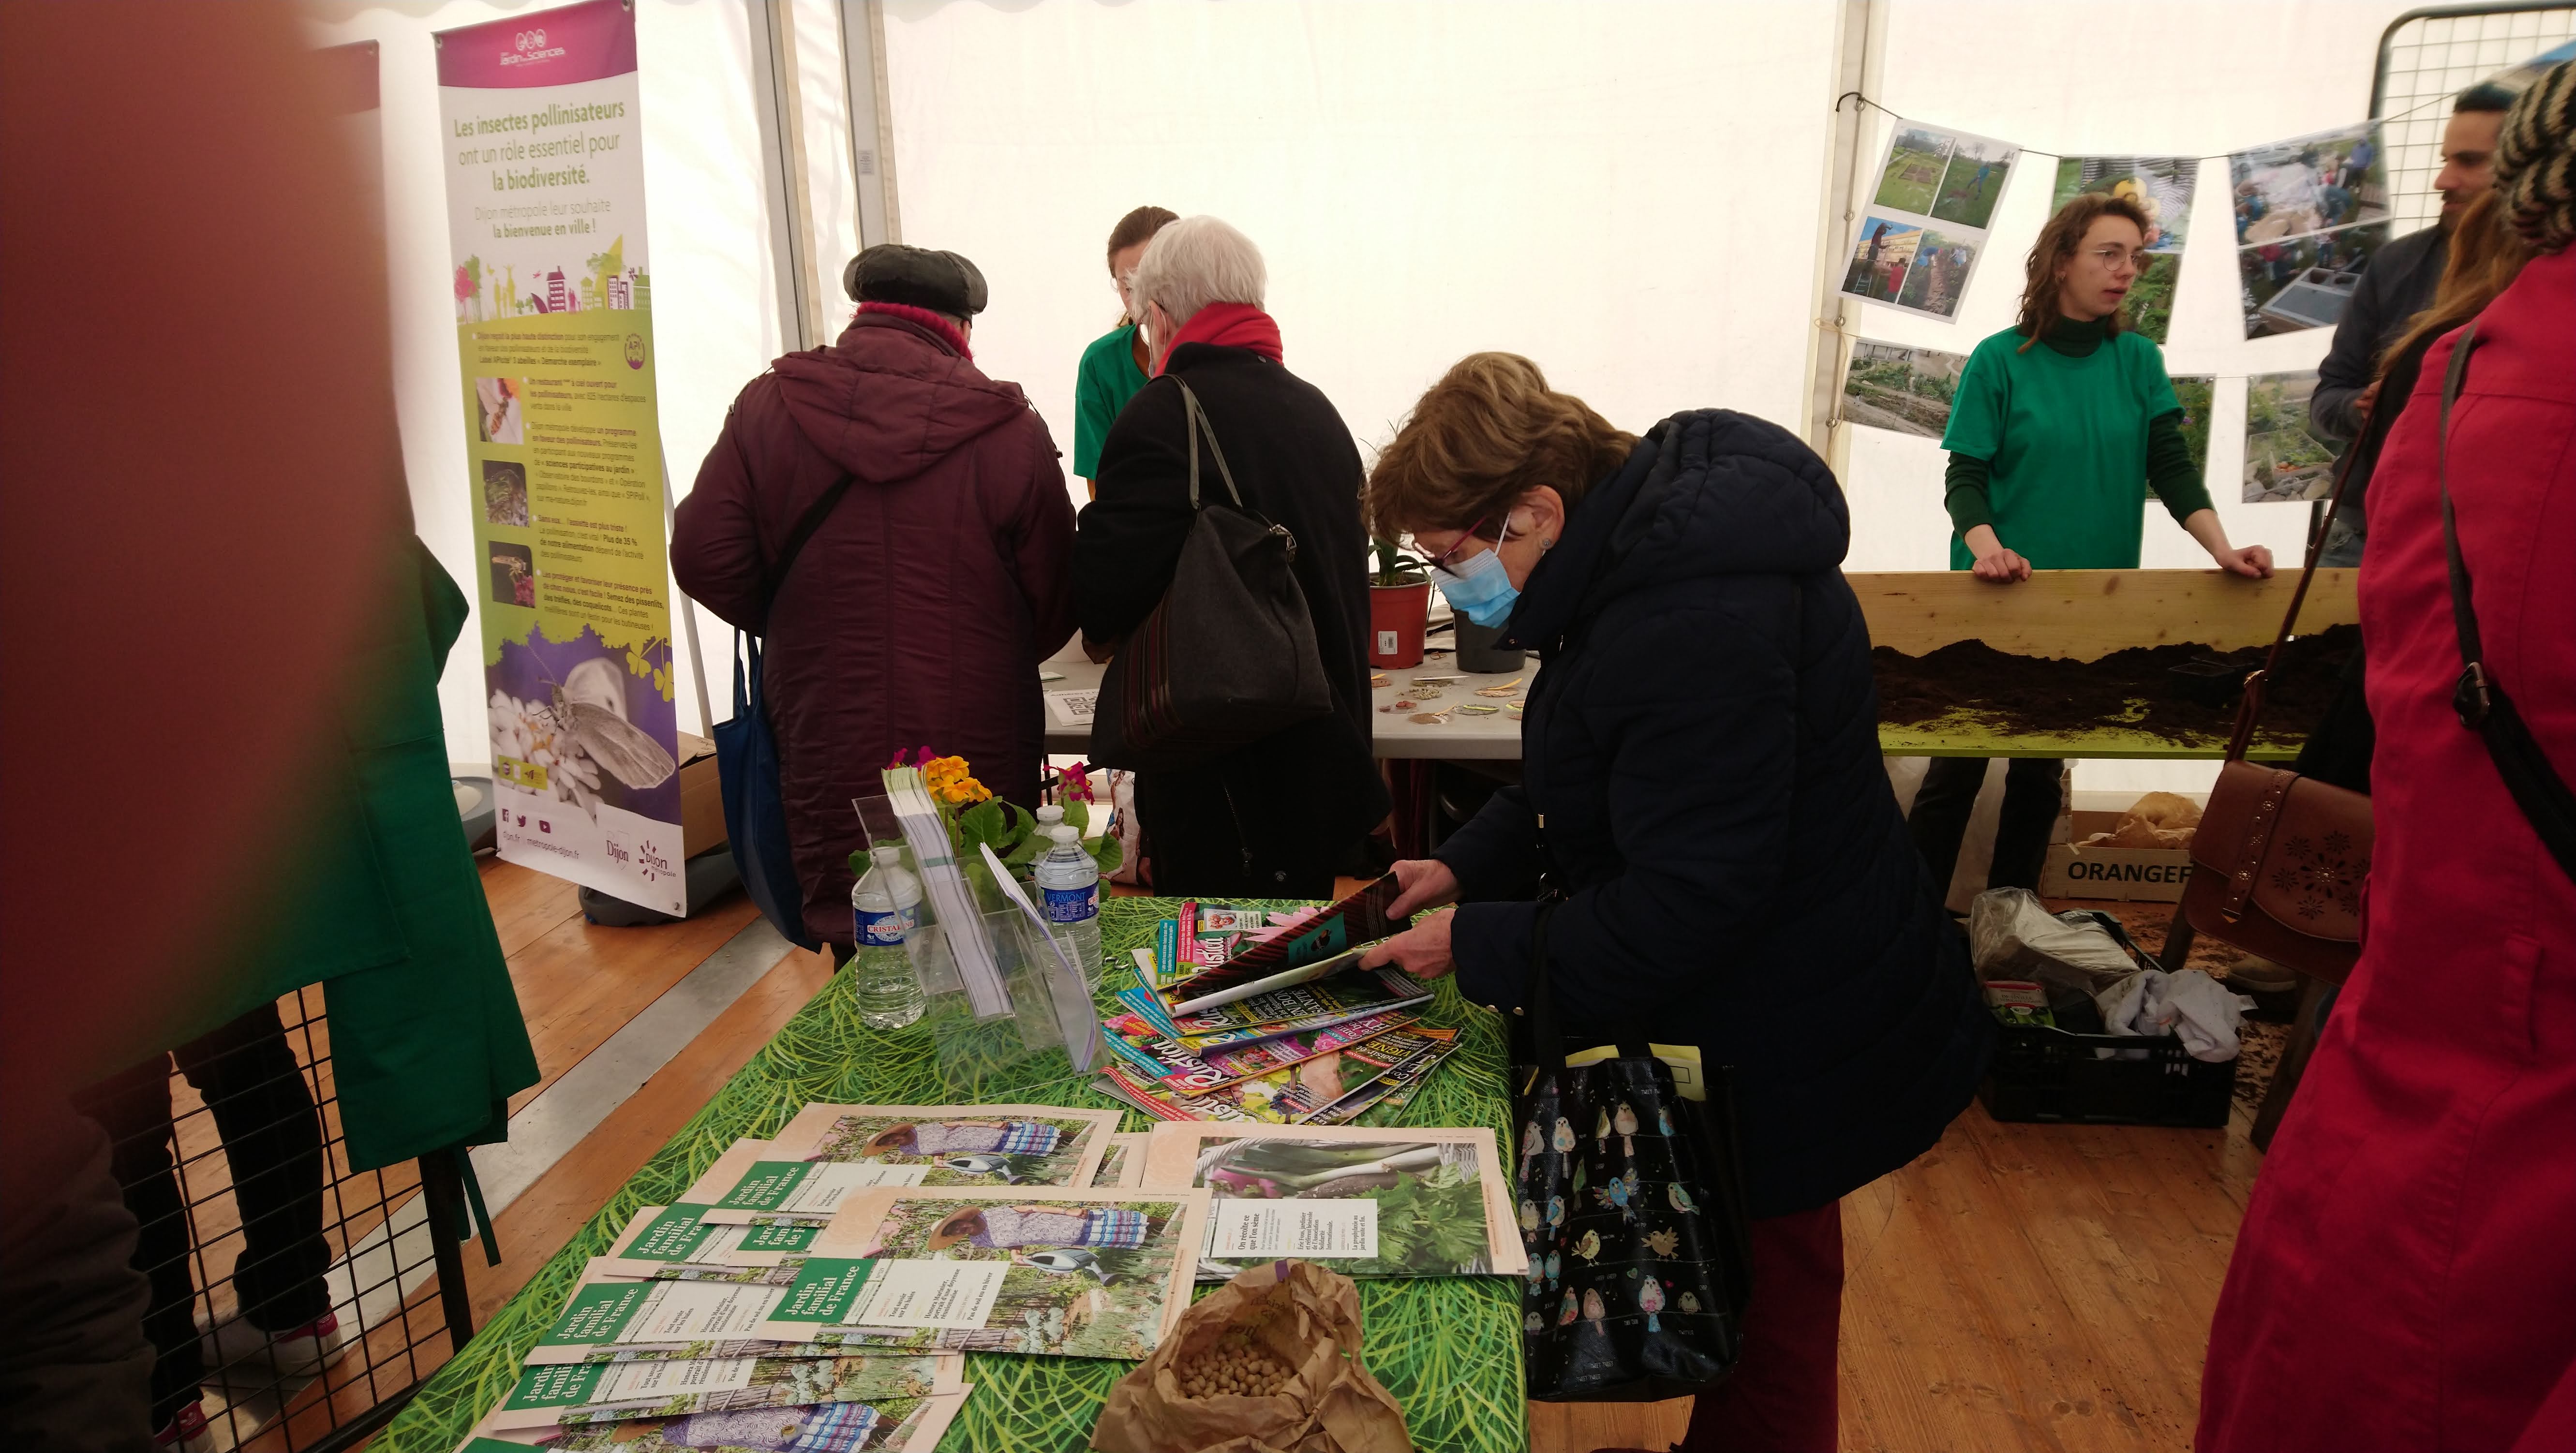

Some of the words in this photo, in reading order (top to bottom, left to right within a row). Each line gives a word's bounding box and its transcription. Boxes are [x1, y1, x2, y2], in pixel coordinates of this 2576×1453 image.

[454, 119, 474, 137] Les
[476, 114, 528, 135] insectes
[532, 102, 625, 135] pollinisateurs
[460, 148, 478, 165] ont
[482, 147, 496, 163] un
[501, 139, 524, 161] rôle
[529, 131, 585, 158] essentiel
[589, 134, 620, 159] pour
[492, 170, 504, 191] la
[507, 164, 590, 190] biodiversité.
[570, 197, 611, 214] souhaite
[493, 224, 501, 238] la
[504, 223, 551, 237] bienvenue
[555, 224, 566, 235] en
[568, 219, 590, 234] ville
[603, 534, 614, 543] Plus
[615, 535, 622, 544] de
[625, 596, 635, 605] des
[606, 840, 628, 863] Dijon
[1047, 892, 1086, 902] VERMONT
[868, 920, 914, 932] CRISTALNE
[1286, 1007, 1308, 1017] EN
[1347, 1051, 1374, 1064] GOURMAND
[1365, 1041, 1412, 1057] VIGNE
[1367, 1049, 1402, 1063] Choisir
[1151, 1039, 1230, 1087] Rustica
[1230, 1064, 1250, 1075] RECETTES
[1211, 1092, 1233, 1105] jardinage
[1285, 1098, 1310, 1112] RECETTES
[728, 1179, 760, 1205] Jardin
[741, 1175, 779, 1206] familial
[758, 1192, 773, 1206] de
[772, 1166, 801, 1191] France
[637, 1219, 676, 1254] Jardin
[652, 1216, 695, 1256] familial
[668, 1240, 686, 1256] de
[682, 1224, 703, 1245] Fra
[785, 1232, 800, 1246] de
[1239, 1222, 1250, 1239] récolte
[1237, 1240, 1245, 1250] On
[784, 1282, 818, 1315] Jardin
[801, 1276, 838, 1316] familial
[818, 1302, 834, 1316] de
[830, 1265, 860, 1302] France
[908, 1290, 916, 1303] haies
[924, 1300, 937, 1319] Honora
[935, 1279, 950, 1301] Marinier,
[933, 1297, 945, 1319] portrait
[943, 1286, 952, 1298] d'une
[950, 1268, 961, 1288] doyenne
[592, 1325, 607, 1337] de
[603, 1288, 639, 1323] France
[700, 1315, 715, 1333] Honora
[712, 1297, 730, 1316] Marinier,
[709, 1313, 723, 1333] portrait
[721, 1304, 730, 1314] d'une
[729, 1286, 743, 1305] doyenne
[744, 1321, 753, 1331] Pas
[766, 1288, 775, 1301] hiver
[889, 1305, 898, 1318] Tout
[897, 1293, 907, 1306] savoir
[940, 1289, 959, 1320] réunionnaise
[967, 1310, 975, 1320] Pas
[556, 1306, 594, 1339] Jardin
[574, 1299, 615, 1338] familial
[663, 1321, 675, 1334] Tout
[673, 1310, 685, 1323] savoir
[673, 1325, 682, 1334] sur
[685, 1308, 694, 1320] haies
[718, 1305, 738, 1332] réunionnaise
[640, 1376, 650, 1389] Tout
[648, 1363, 658, 1377] savoir
[660, 1359, 669, 1373] haies
[681, 1368, 692, 1385] Honora
[690, 1366, 700, 1384] portrait
[523, 1364, 557, 1402] Jardin
[541, 1364, 573, 1400] famili
[562, 1384, 577, 1398] de
[575, 1364, 593, 1384] Fra
